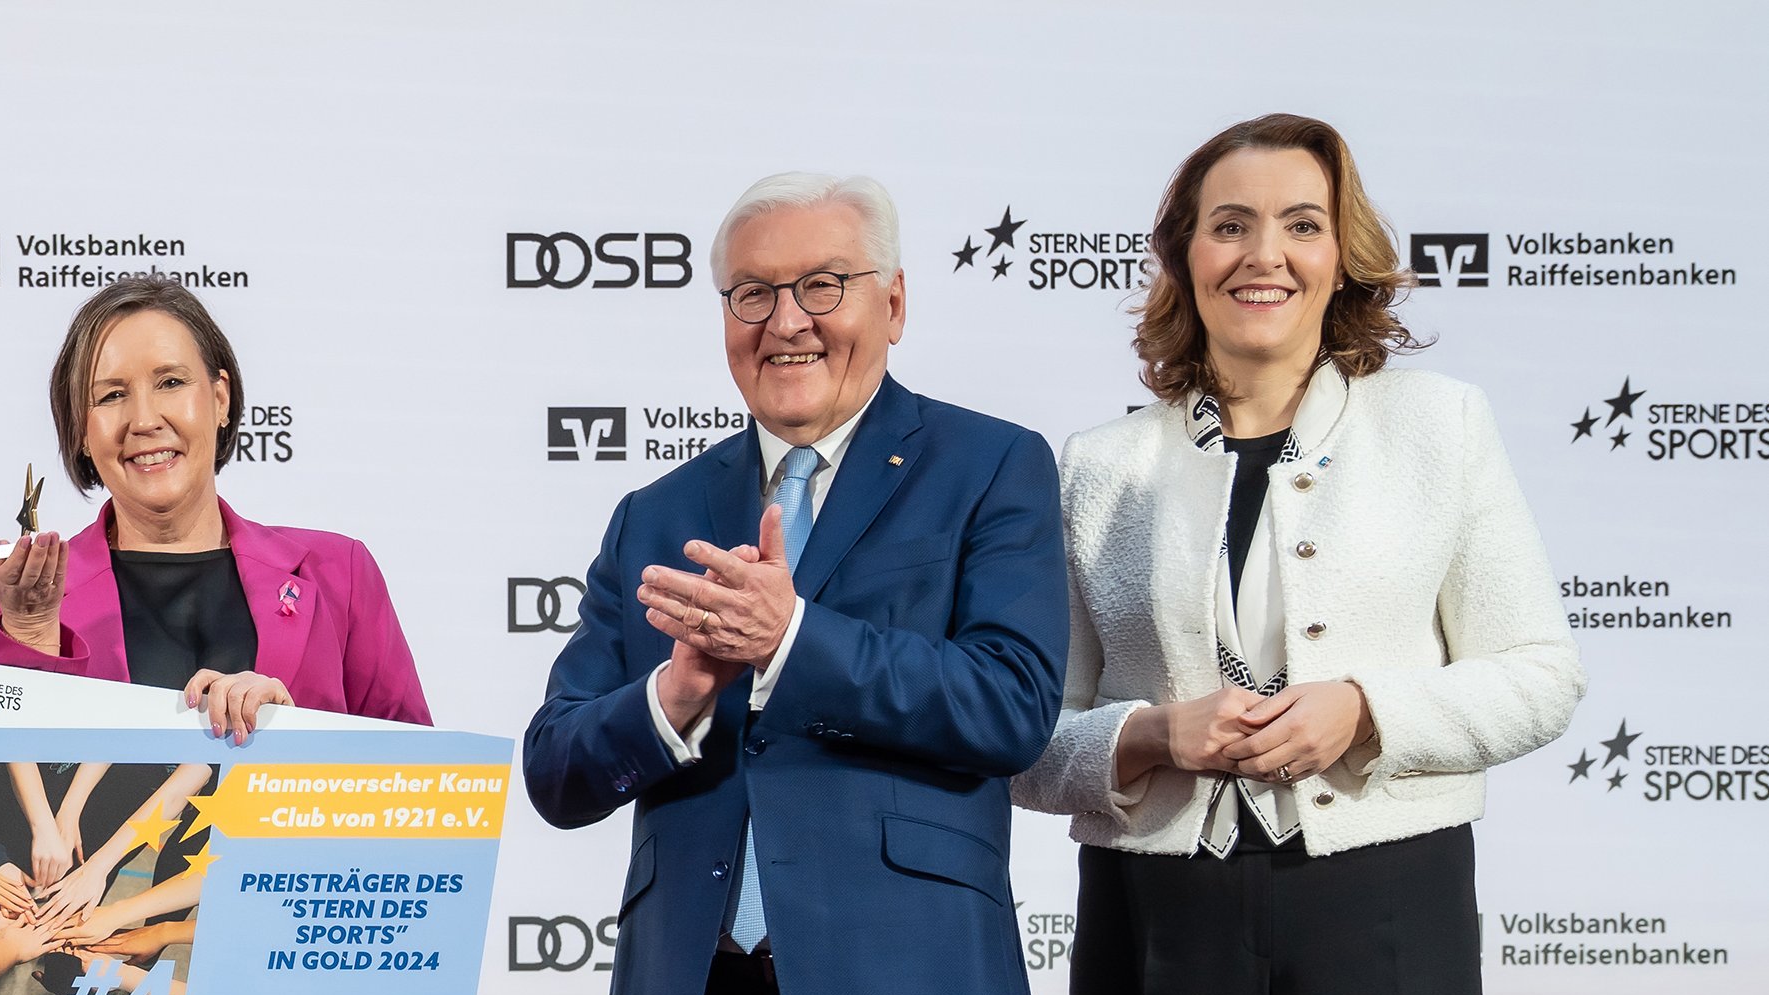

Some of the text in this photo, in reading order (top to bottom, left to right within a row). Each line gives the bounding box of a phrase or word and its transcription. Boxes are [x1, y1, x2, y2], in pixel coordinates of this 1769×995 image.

[17, 234, 184, 256] Volksbanken
[1029, 233, 1110, 254] STERNE
[1507, 233, 1673, 254] Volksbanken
[507, 232, 692, 289] DOSB
[1509, 263, 1735, 285] Raiffeisenbanken
[251, 406, 292, 427] DES
[1648, 404, 1730, 424] STERNE
[5, 685, 23, 696] DES
[1644, 746, 1726, 765] STERNE
[247, 772, 502, 793] Hannoverscher Kanu
[1644, 770, 1769, 802] SPORTS
[332, 812, 376, 827] von
[382, 807, 436, 827] 1921
[442, 808, 489, 828] e.V.
[240, 868, 463, 894] PREISTRÄGER DES
[381, 899, 428, 919] DES
[1501, 913, 1665, 934] Volksbanken
[267, 951, 440, 971] IN GOLD 2024
[1503, 943, 1727, 965] Raiffeisenbanken
